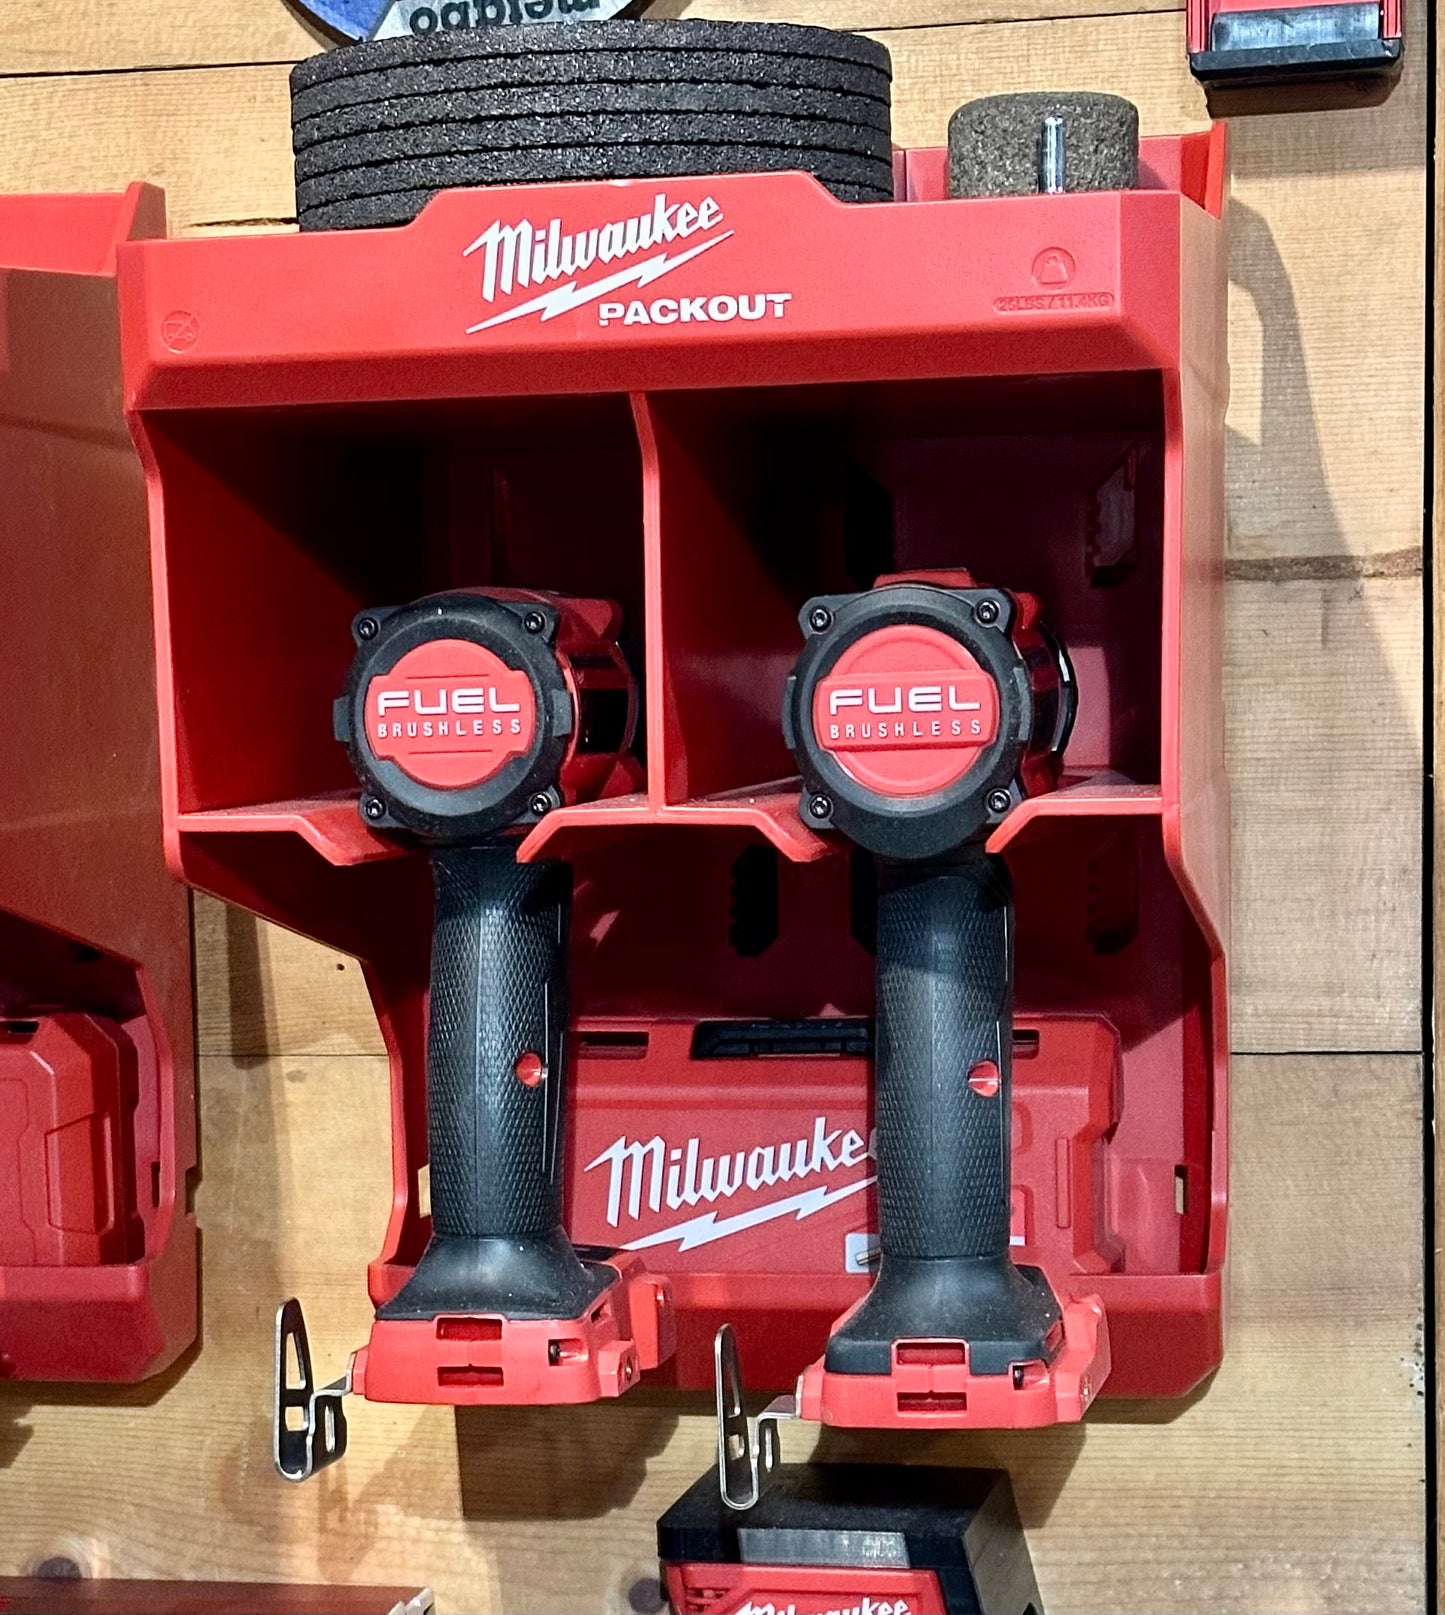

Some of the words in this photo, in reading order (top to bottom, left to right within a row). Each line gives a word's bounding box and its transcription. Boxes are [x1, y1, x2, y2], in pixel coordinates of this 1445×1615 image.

[463, 193, 724, 302] Milwaukee
[599, 293, 792, 326] PACKOUT
[377, 687, 521, 717] FUEL
[829, 685, 981, 715] FUEL
[377, 718, 521, 739] BRUSHLESS
[829, 719, 981, 740] BRUSHLESS
